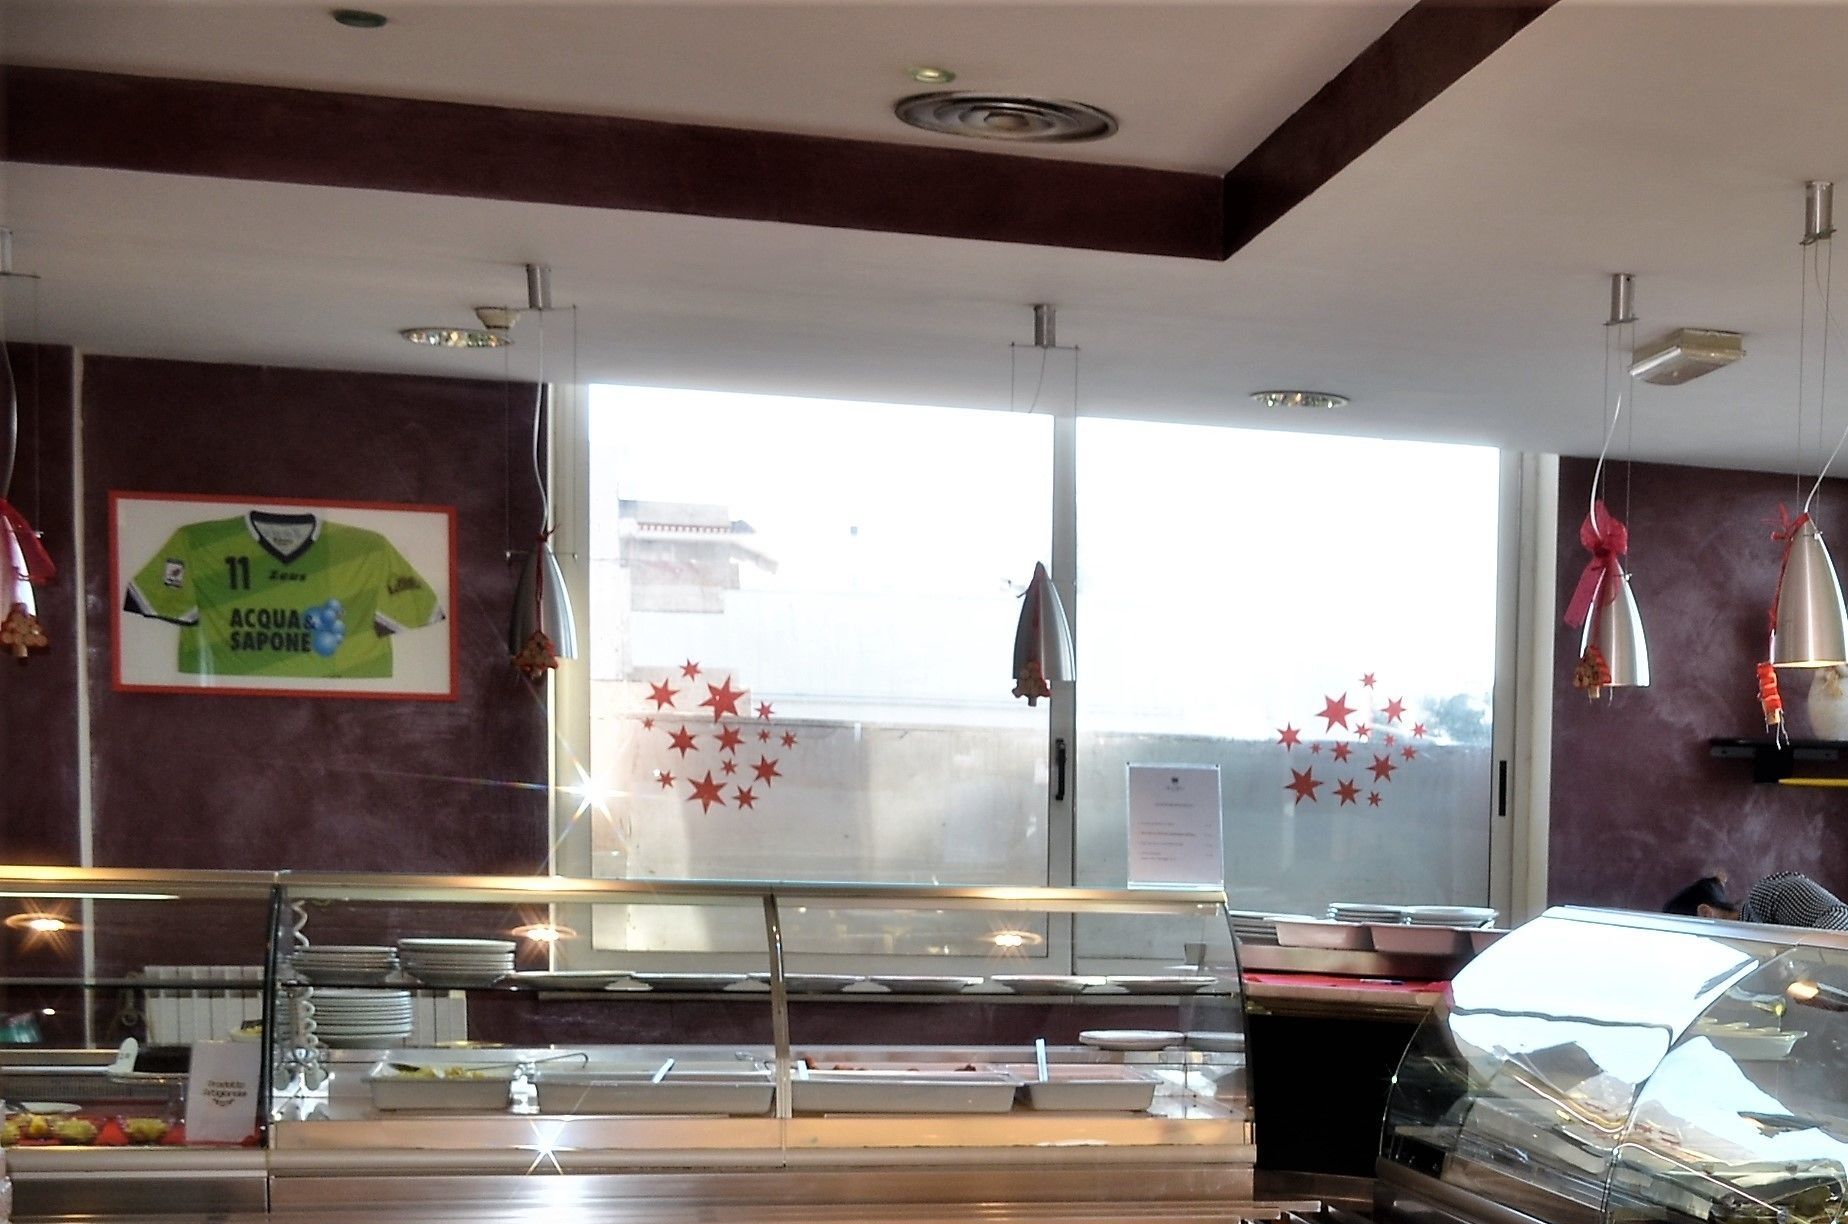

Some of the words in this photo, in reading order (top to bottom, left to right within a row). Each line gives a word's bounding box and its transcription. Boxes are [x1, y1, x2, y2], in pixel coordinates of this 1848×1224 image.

[225, 556, 250, 590] 11
[230, 608, 300, 629] ACQUA
[231, 631, 311, 653] SAPONE
